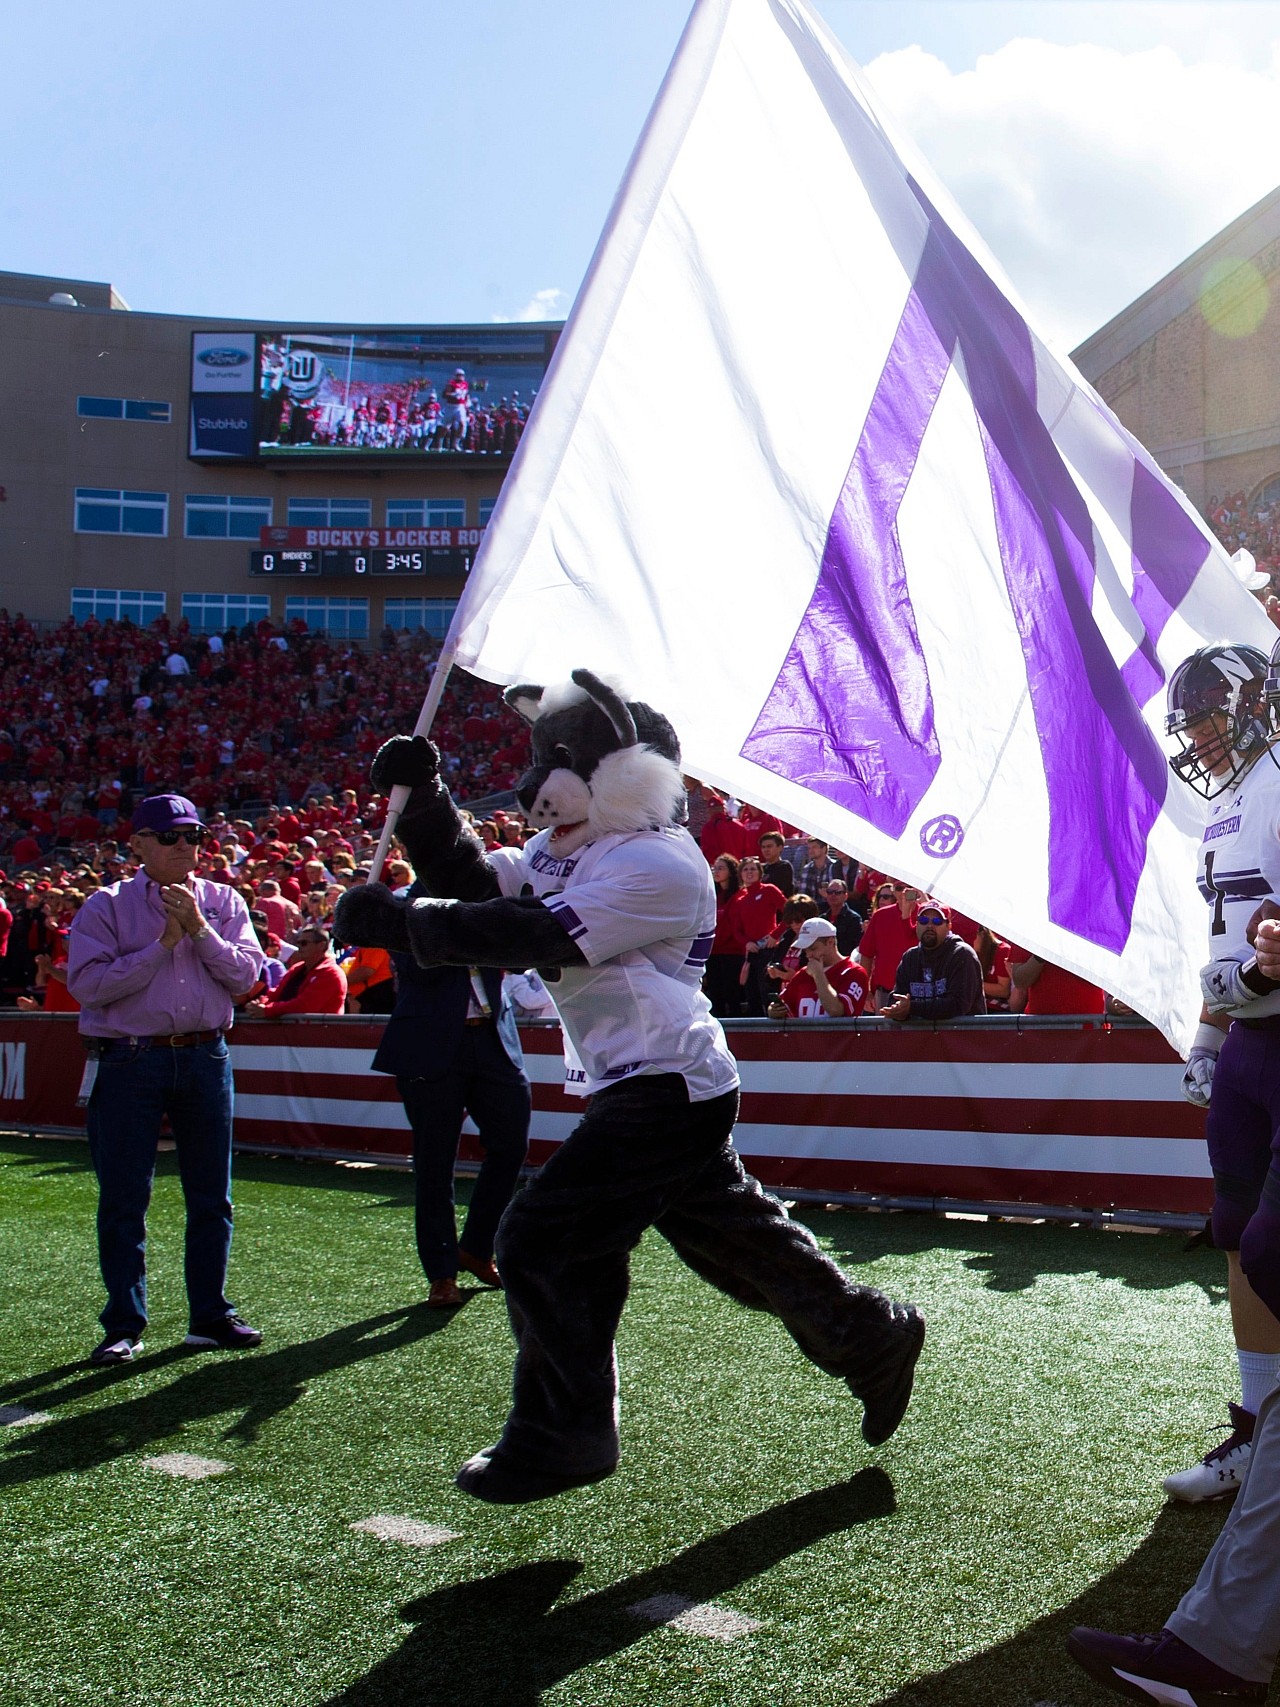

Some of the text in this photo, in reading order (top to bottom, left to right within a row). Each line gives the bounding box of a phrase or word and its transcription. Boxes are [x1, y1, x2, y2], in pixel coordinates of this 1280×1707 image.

[198, 417, 248, 430] StubHub
[306, 530, 380, 546] BUCKY'S
[385, 530, 452, 546] LOCKER
[263, 554, 274, 571] 0
[354, 557, 366, 574] 0
[386, 553, 422, 570] 3:45
[1204, 850, 1226, 936] 1
[848, 981, 864, 1001] 99
